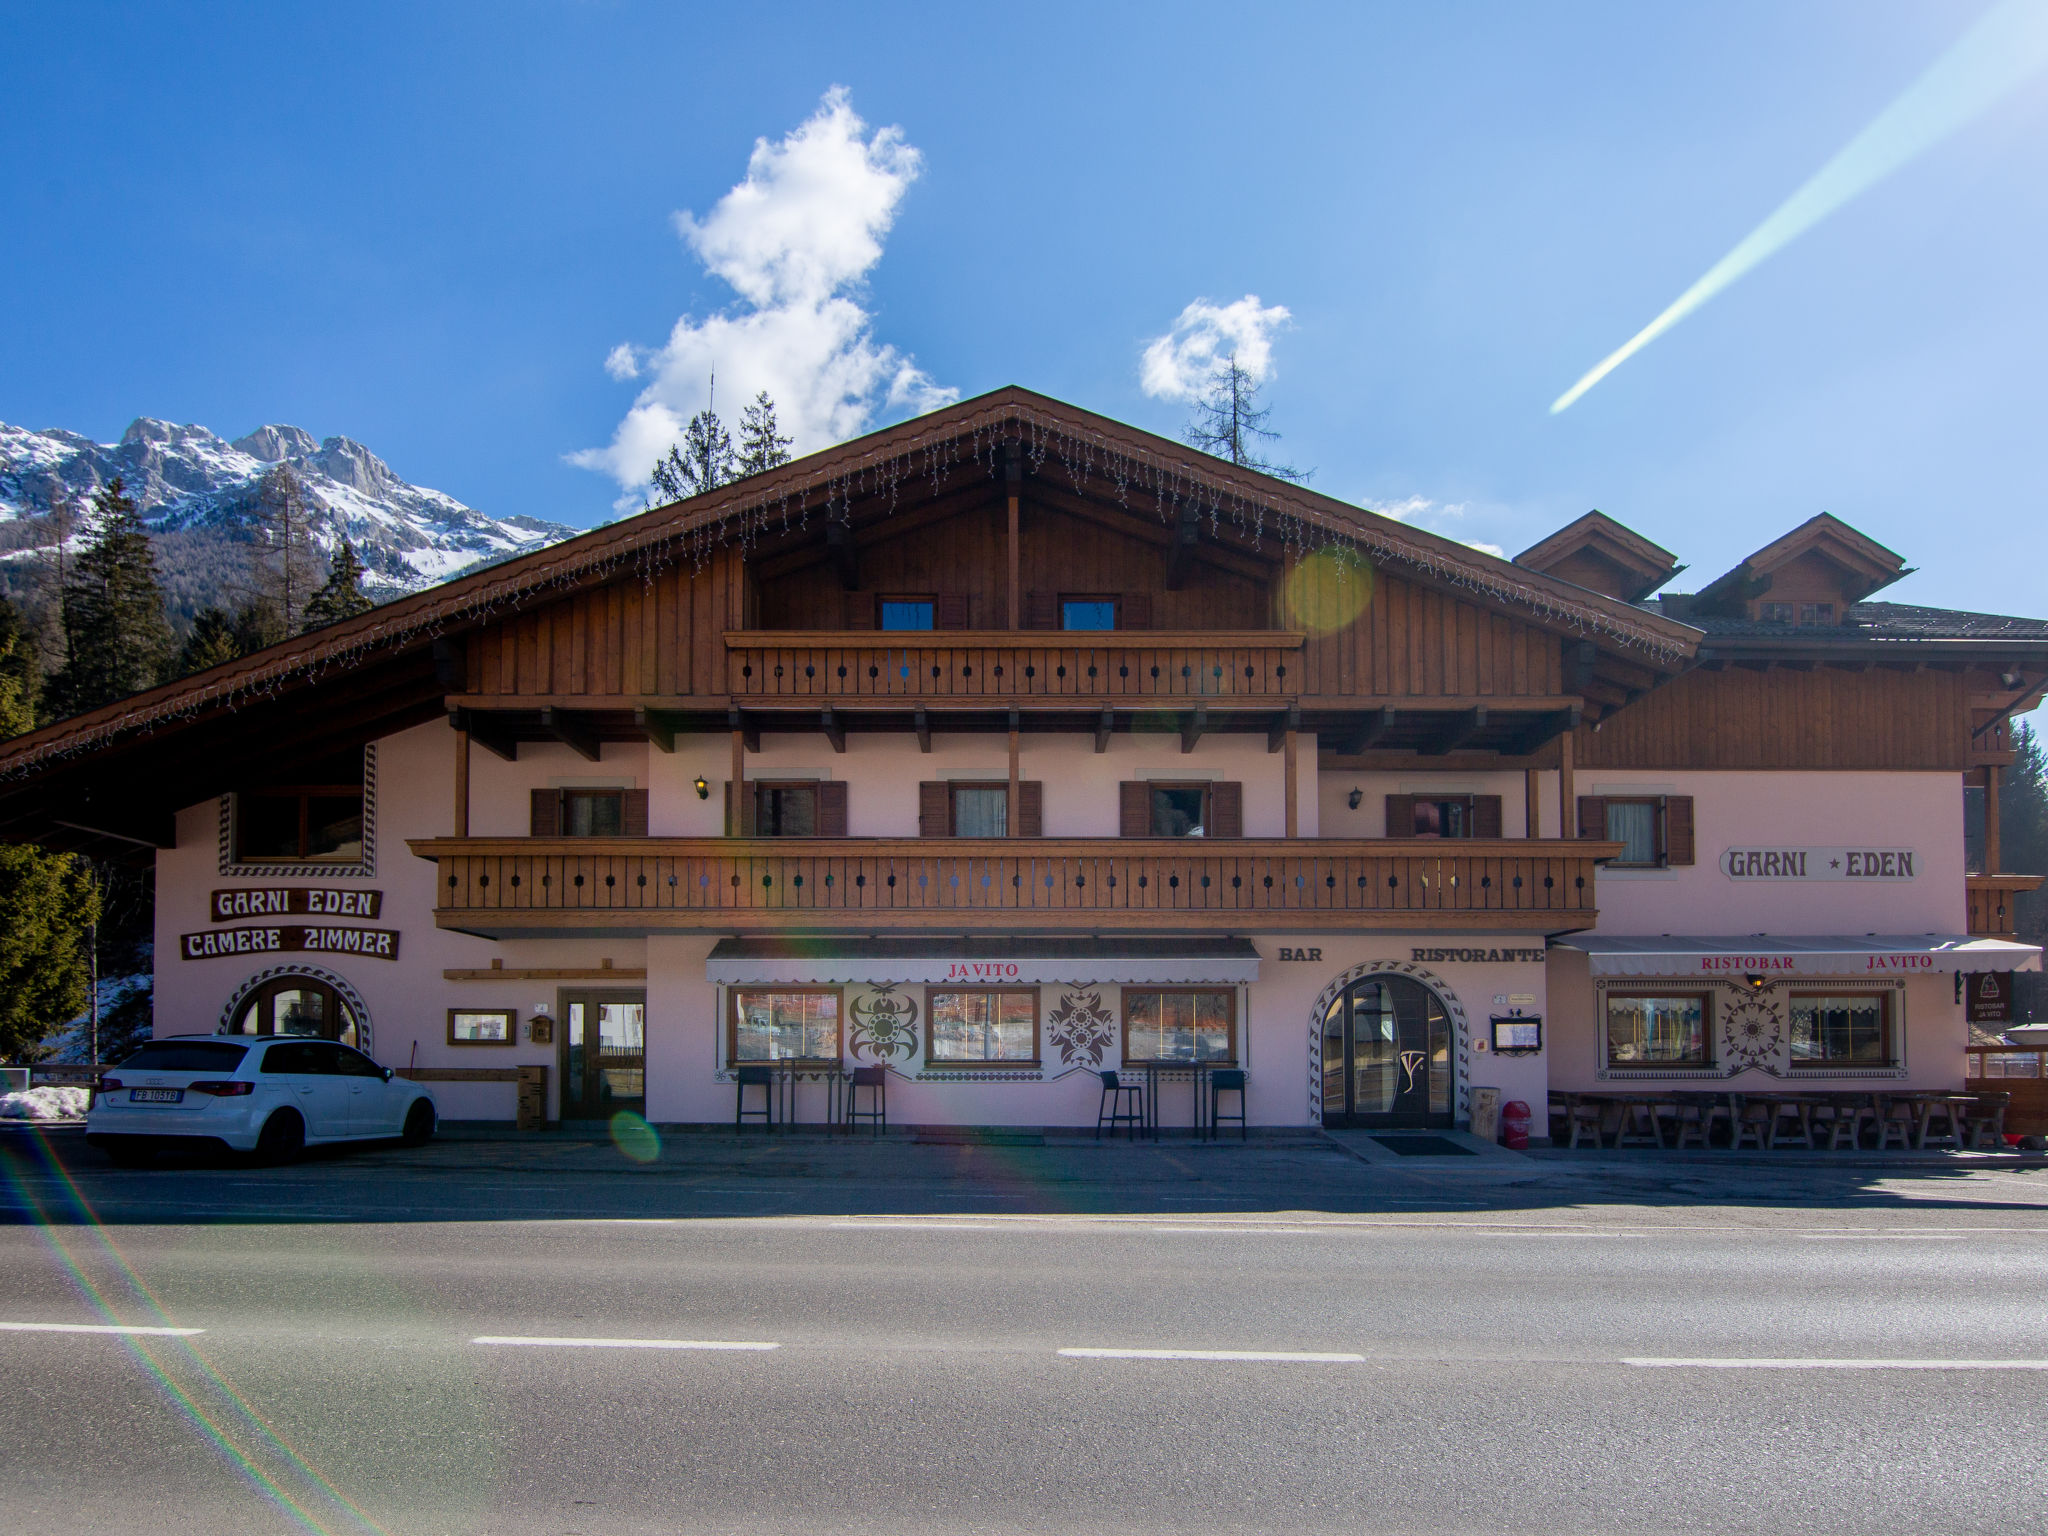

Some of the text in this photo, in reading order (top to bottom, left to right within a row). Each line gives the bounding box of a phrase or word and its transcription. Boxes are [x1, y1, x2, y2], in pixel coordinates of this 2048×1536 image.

[1728, 851, 1914, 877] GARNI EDEN
[217, 890, 373, 915] GARNI EDEN
[187, 928, 392, 957] CAMERE ZIMMER
[1278, 947, 1545, 962] BAR RISTORANTE
[1701, 957, 1795, 970] RISTOBAR
